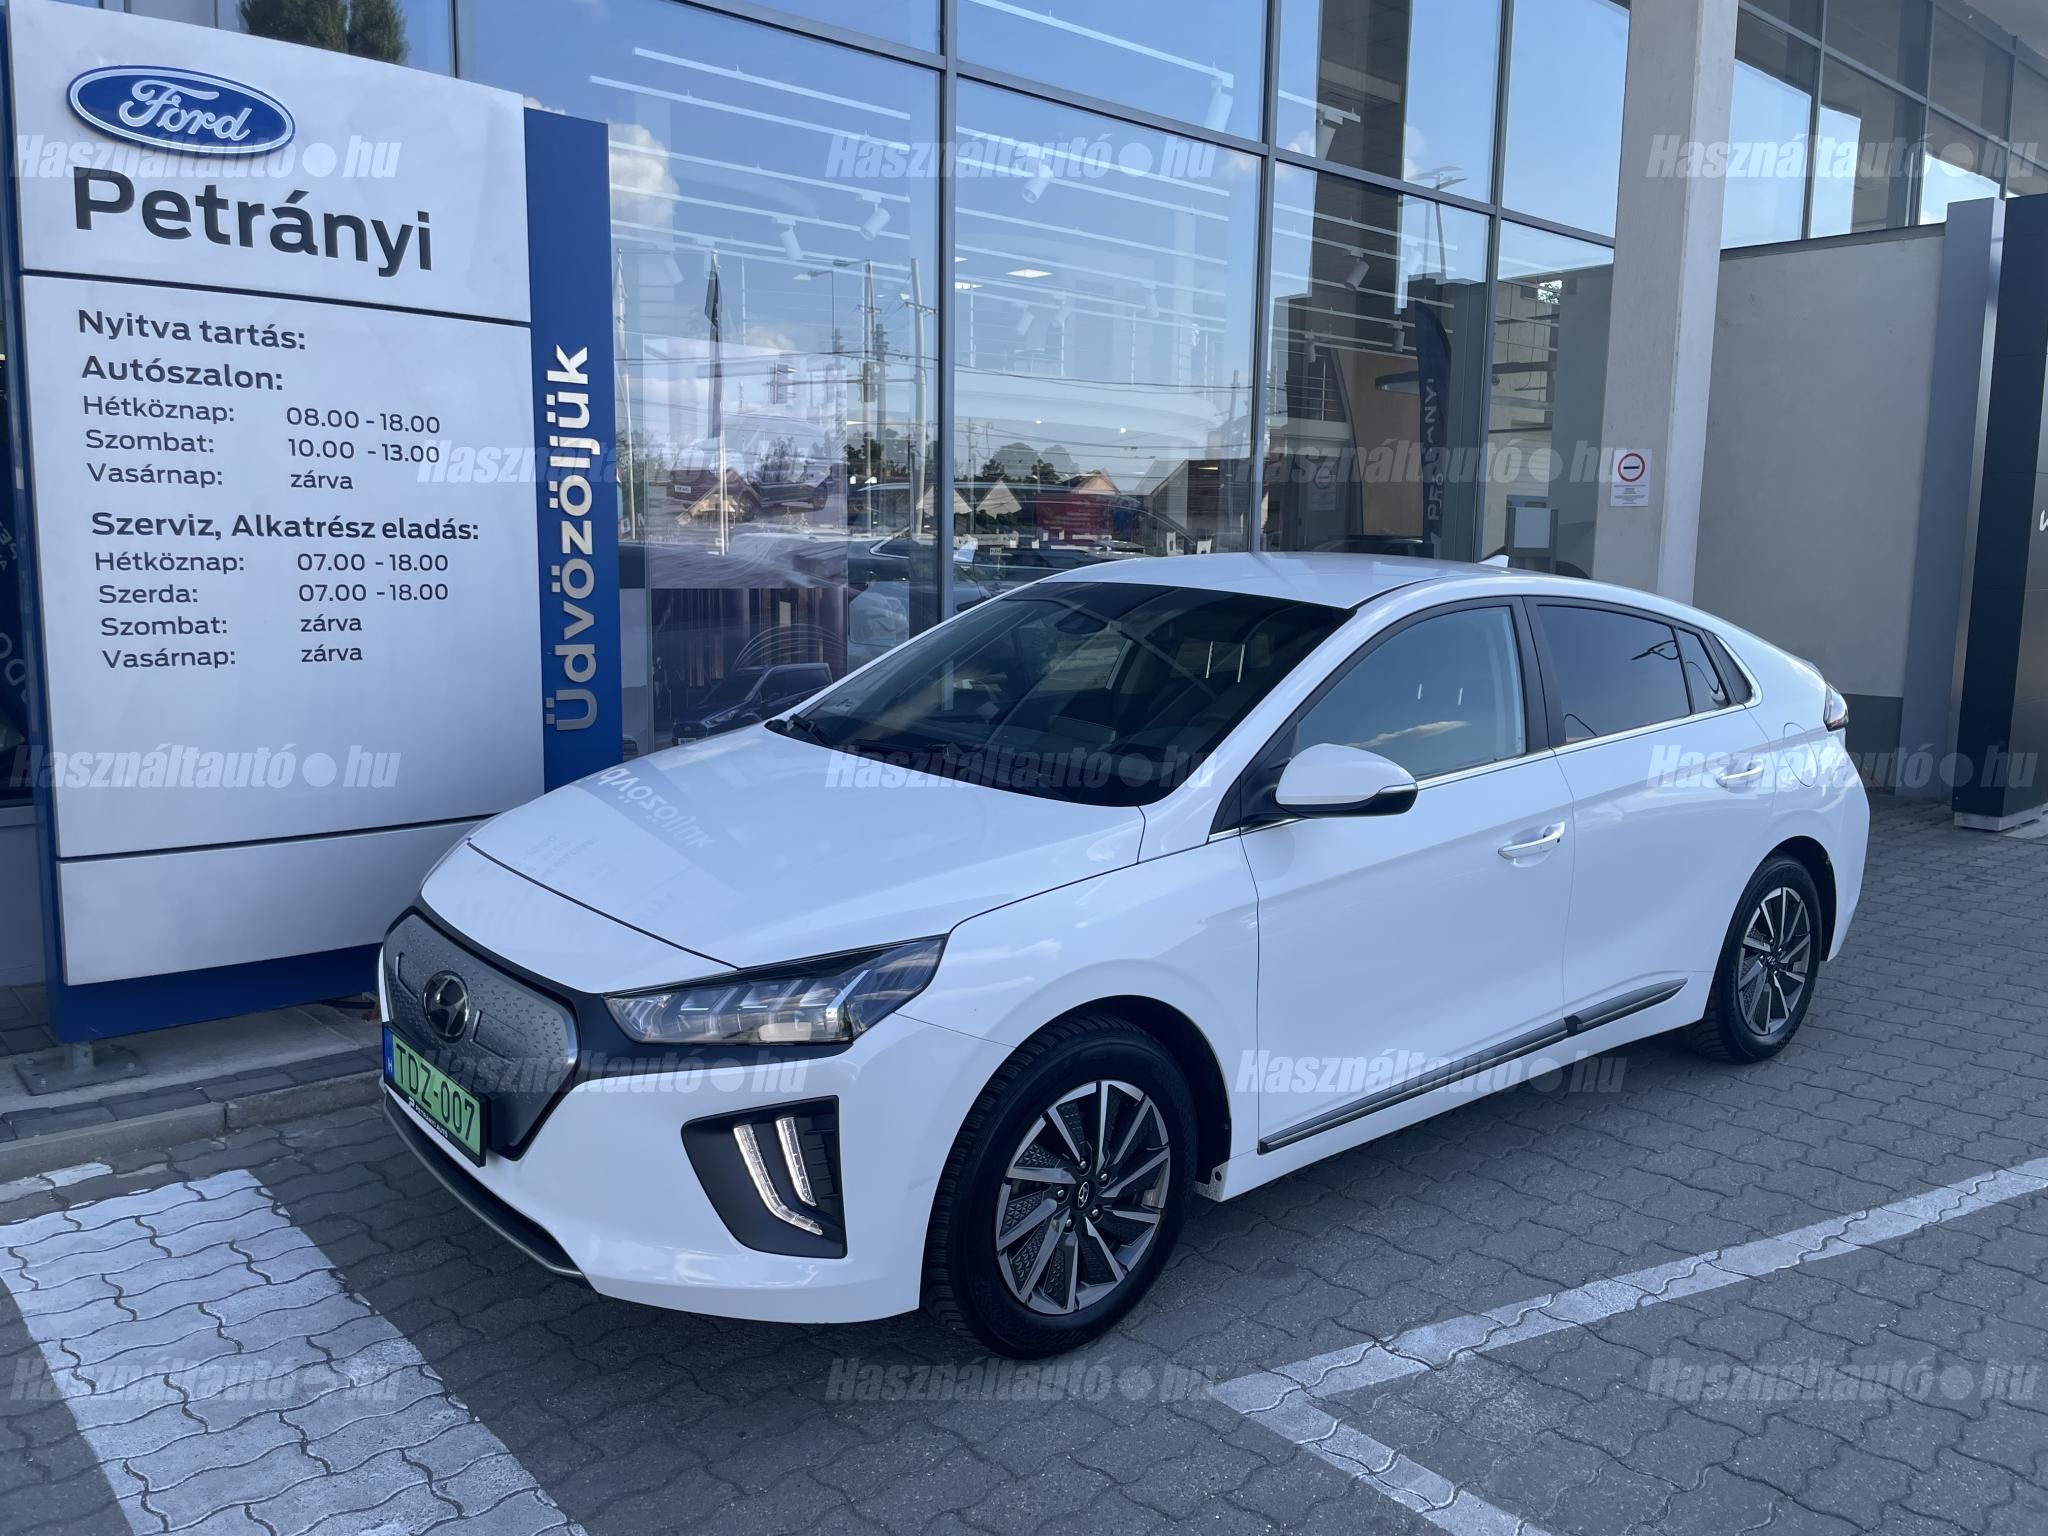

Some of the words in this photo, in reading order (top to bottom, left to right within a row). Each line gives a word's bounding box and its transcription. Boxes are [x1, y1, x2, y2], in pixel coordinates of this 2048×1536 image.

[119, 79, 253, 142] Ford
[72, 166, 433, 278] Petrányi
[78, 309, 192, 341] Nyitva
[198, 320, 306, 350] tartás:
[81, 355, 283, 391] Autószalon:
[83, 395, 235, 425] Hétköznap:
[286, 406, 360, 430] 08.00
[85, 429, 215, 453] Szombat:
[287, 438, 355, 460] 10.00
[86, 462, 223, 489] Vasárnap:
[290, 469, 354, 490] zárva
[91, 511, 222, 541] Szerviz,
[231, 513, 376, 539] Alkatrész
[381, 517, 479, 540] eladás:
[545, 344, 600, 732] Üdvözöljük
[95, 551, 245, 575] Hétköznap:
[297, 553, 366, 572] 07.00
[98, 583, 198, 604] Szerda:
[298, 583, 367, 603] 07.00
[101, 615, 228, 637] Szombat:
[300, 613, 363, 633] zárva
[102, 647, 236, 669] Vasárnap:
[301, 643, 363, 663] zárva
[395, 1042, 476, 1142] TDZ-007
